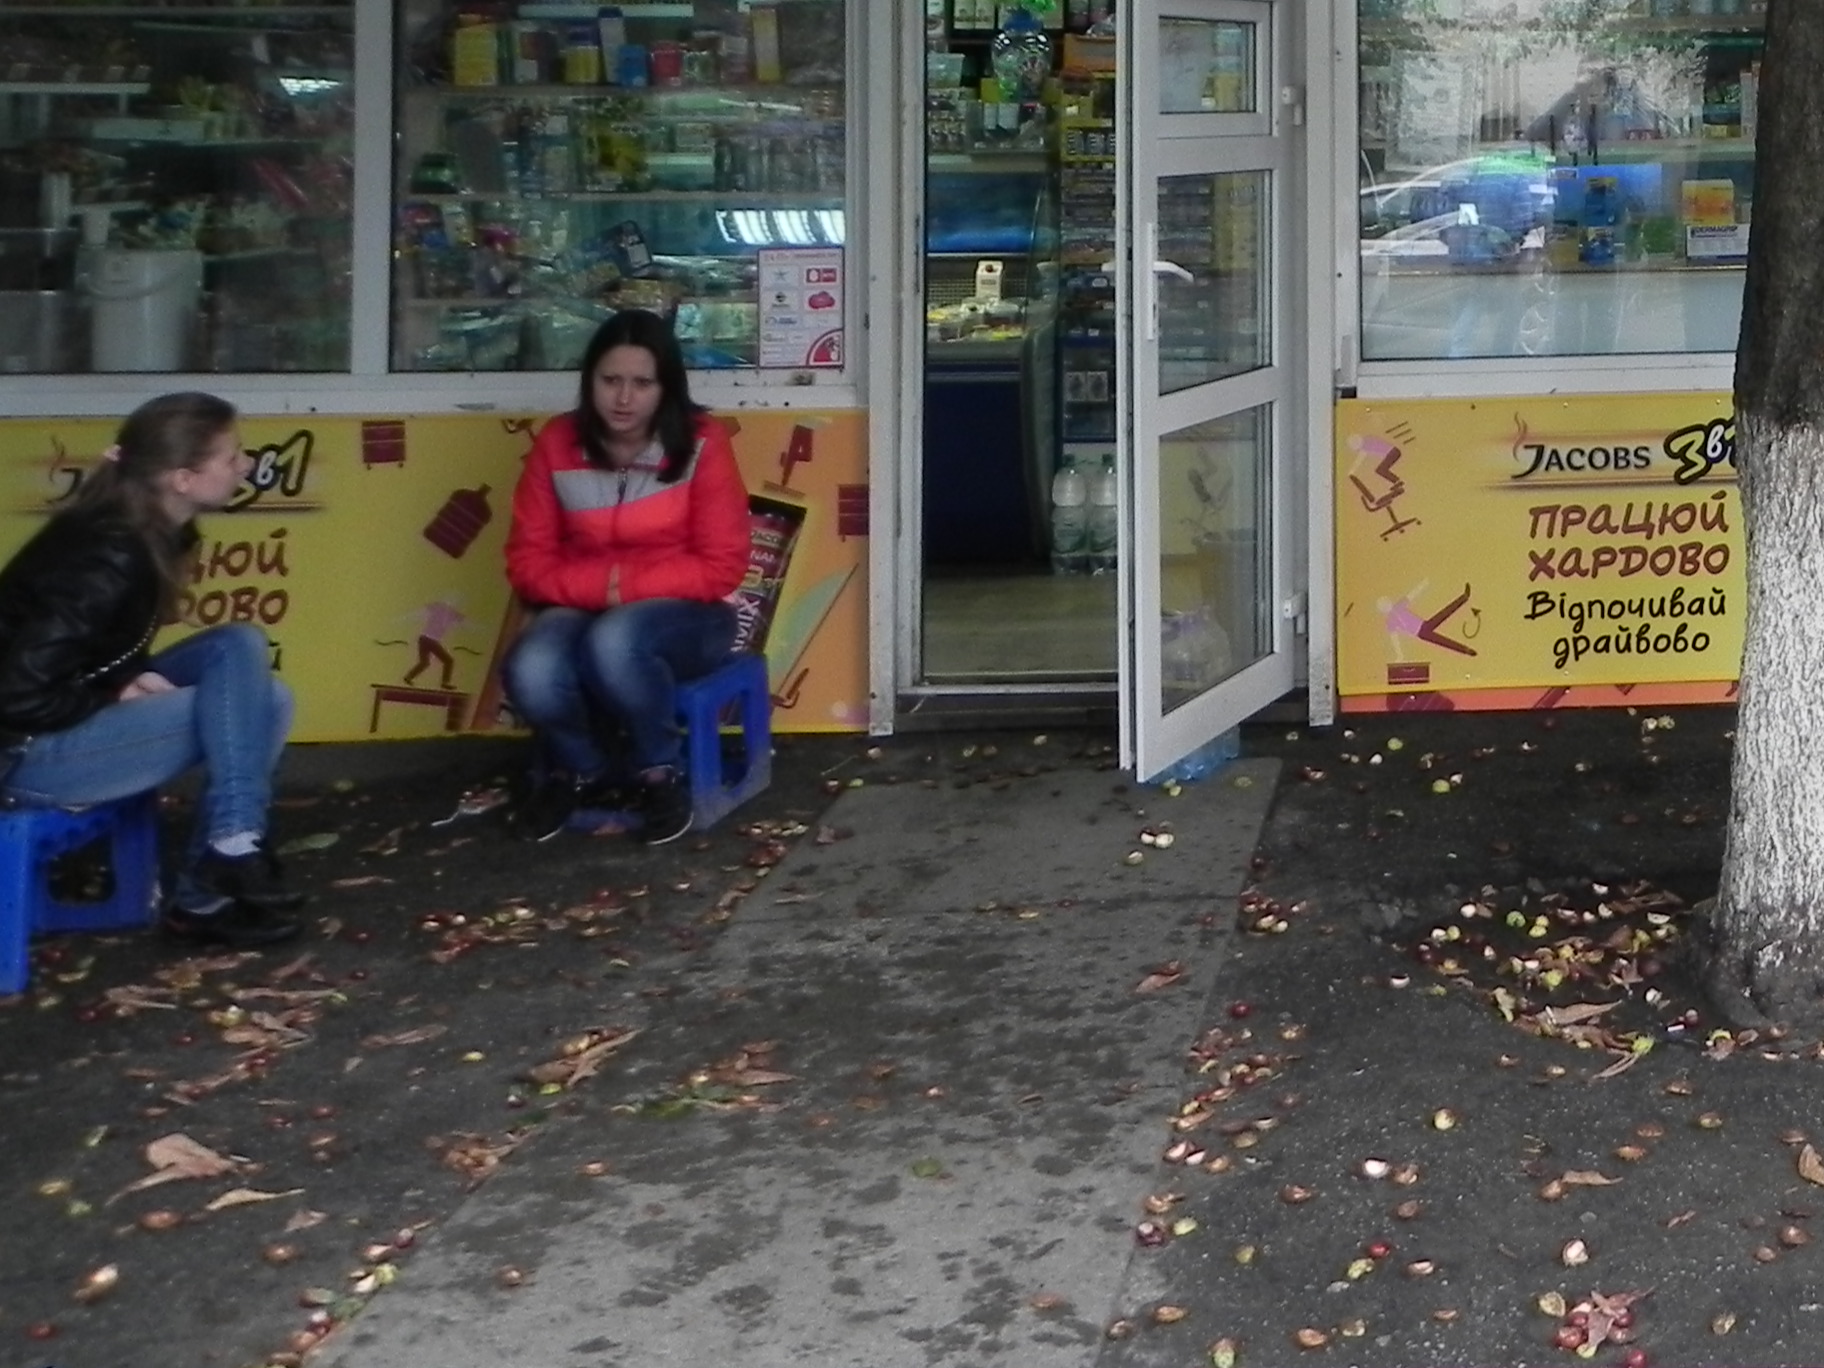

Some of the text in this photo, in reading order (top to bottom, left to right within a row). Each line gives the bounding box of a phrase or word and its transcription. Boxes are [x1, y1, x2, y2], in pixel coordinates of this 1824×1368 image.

[1511, 417, 1736, 486] JACOBS 3в
[1527, 490, 1731, 541] ПРАЦЮЙ
[1527, 541, 1732, 582] ХАРДОВО
[1523, 586, 1727, 634] Відпочивай
[1552, 622, 1711, 670] драйвово
